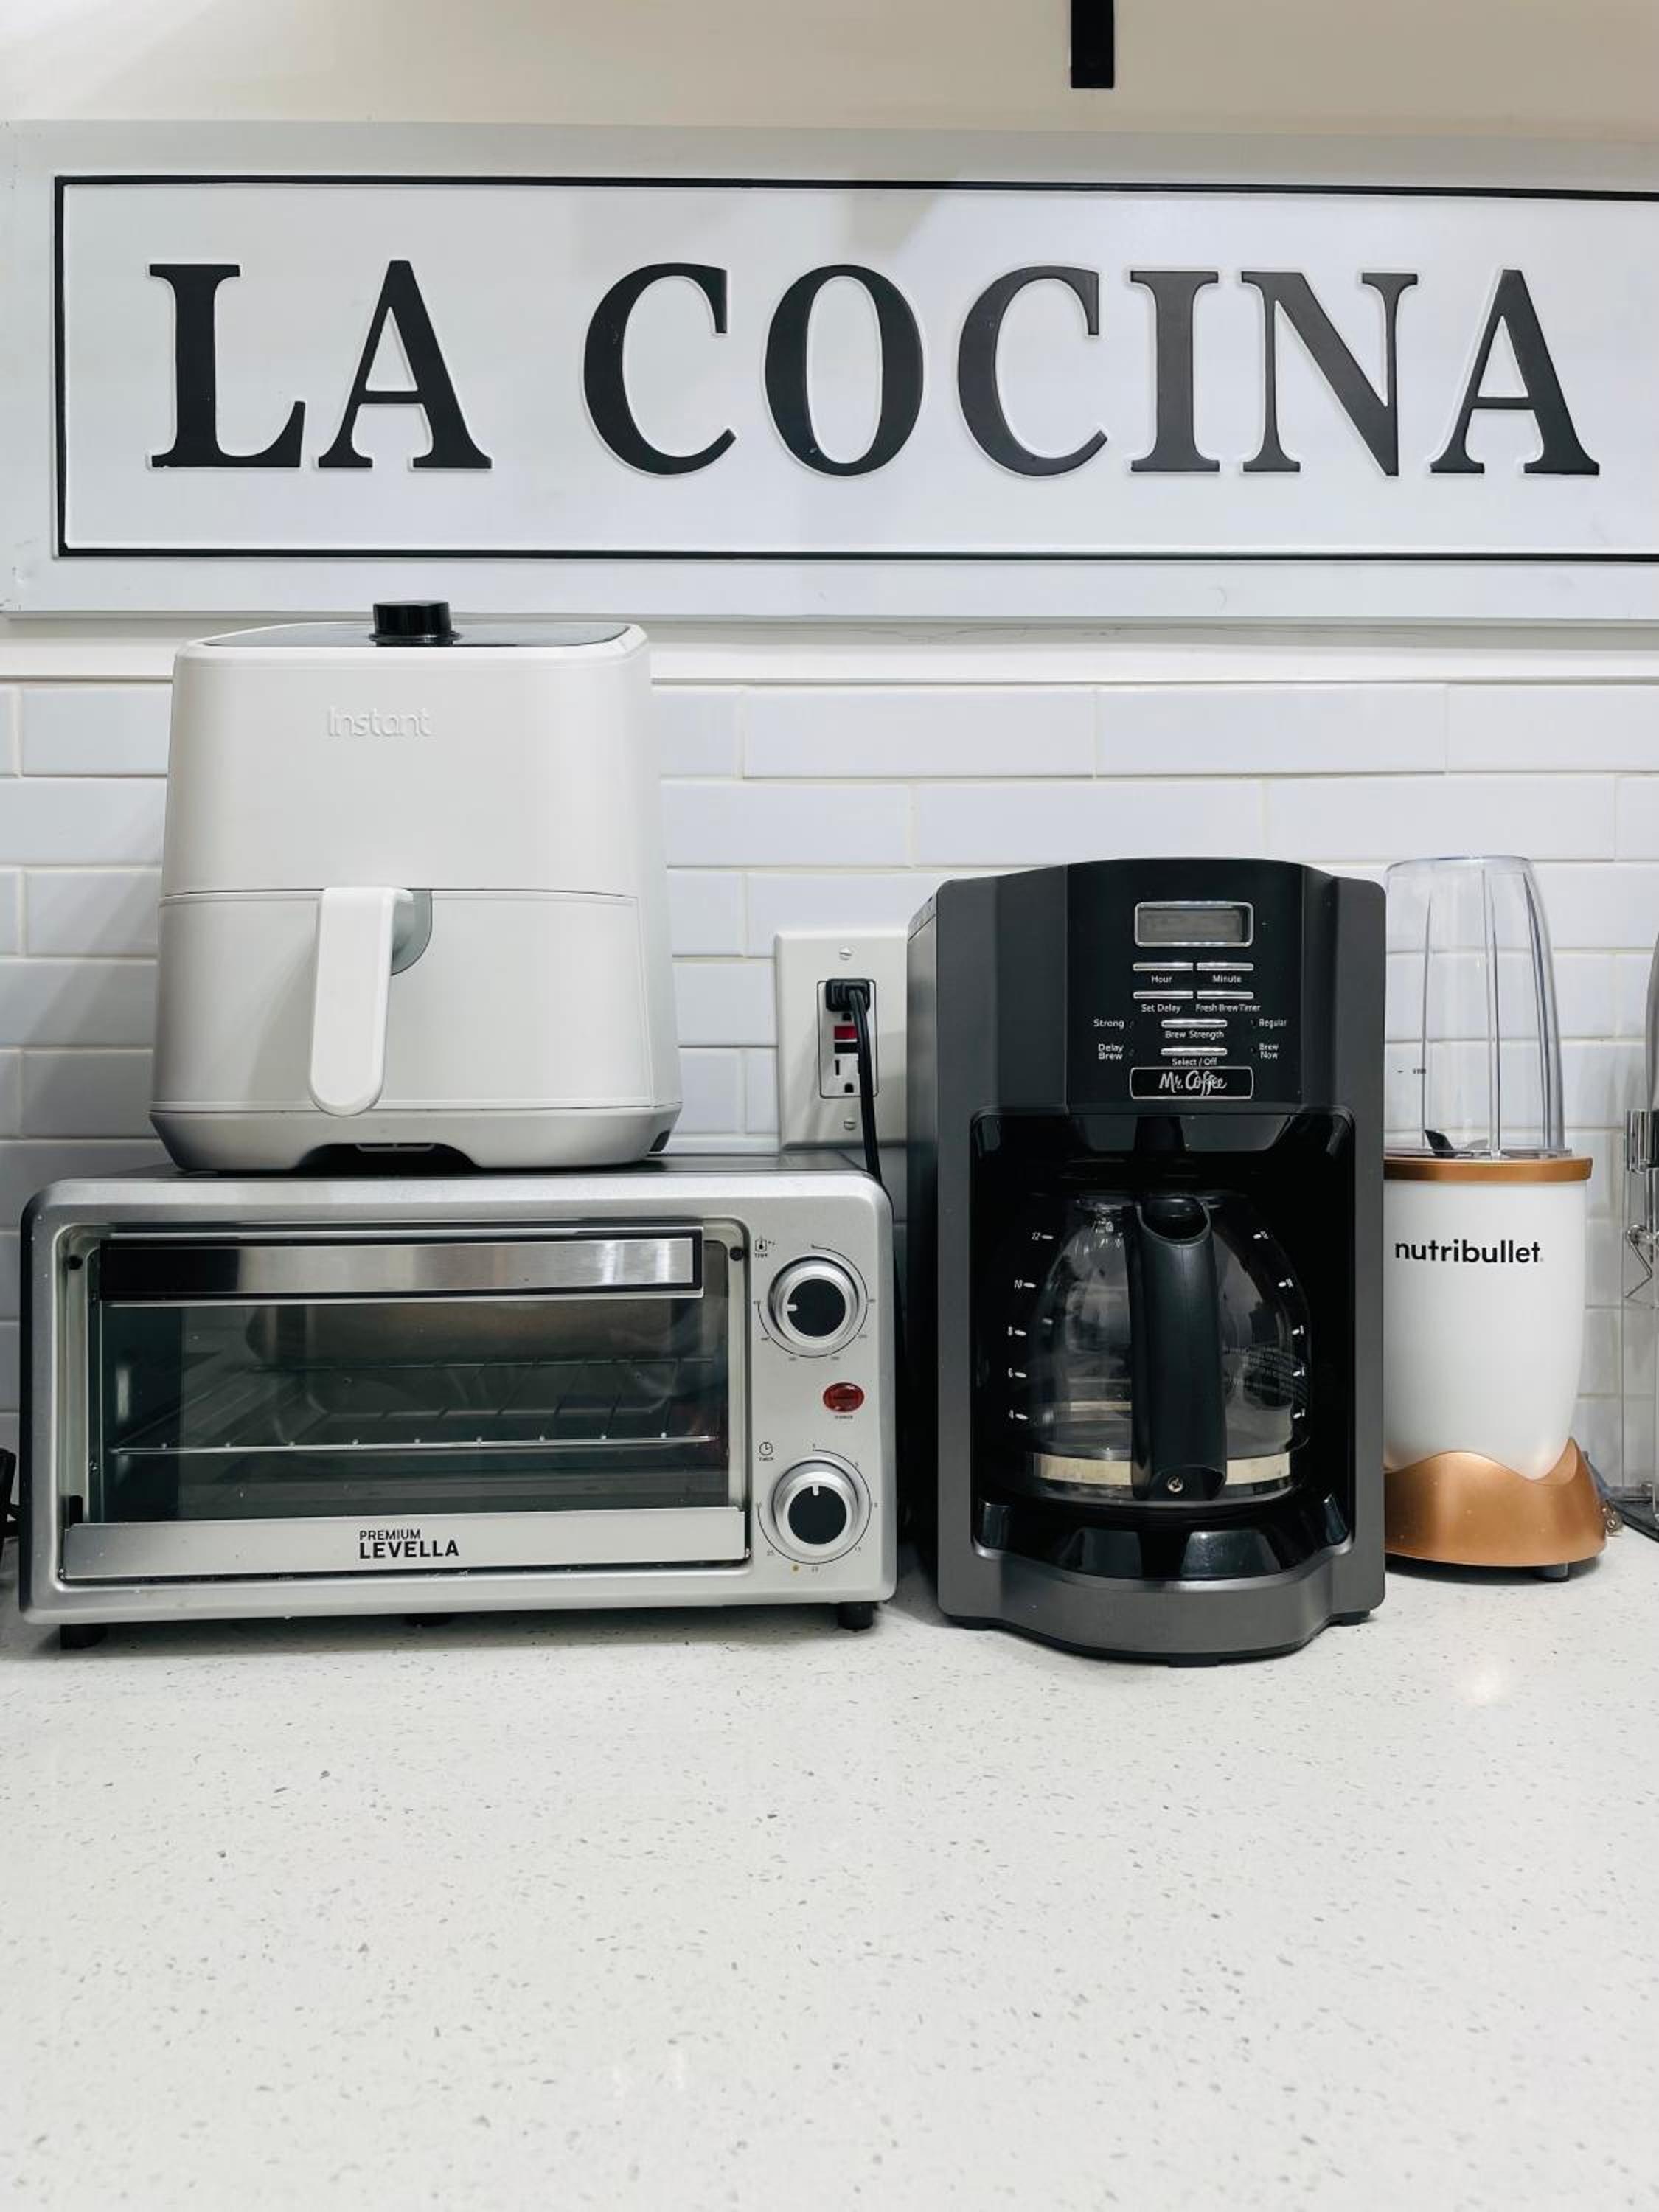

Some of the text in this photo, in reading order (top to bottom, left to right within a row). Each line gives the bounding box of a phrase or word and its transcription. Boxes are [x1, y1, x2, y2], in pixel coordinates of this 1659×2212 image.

[149, 260, 1601, 477] LA COCINA
[328, 706, 431, 737] Instant
[1151, 975, 1172, 983] Hour
[1212, 975, 1242, 983] Minute
[1141, 1004, 1180, 1013] Set Delay
[1195, 1004, 1261, 1012] Fresh Brew Timer
[1093, 1019, 1124, 1029] Strong
[1259, 1018, 1287, 1028] Regular
[1165, 1031, 1224, 1040] Brew Strength
[1098, 1043, 1124, 1053] Delay
[1259, 1043, 1279, 1051] Brew
[1098, 1051, 1123, 1060] Brew
[1260, 1051, 1278, 1060] Now
[1172, 1057, 1197, 1065] Select
[1203, 1057, 1217, 1065] Off
[1158, 1071, 1228, 1097] Mr. Coffee
[1008, 1368, 1014, 1377] 6
[359, 1528, 421, 1540] PREMIUM
[359, 1540, 459, 1559] LEVELLA
